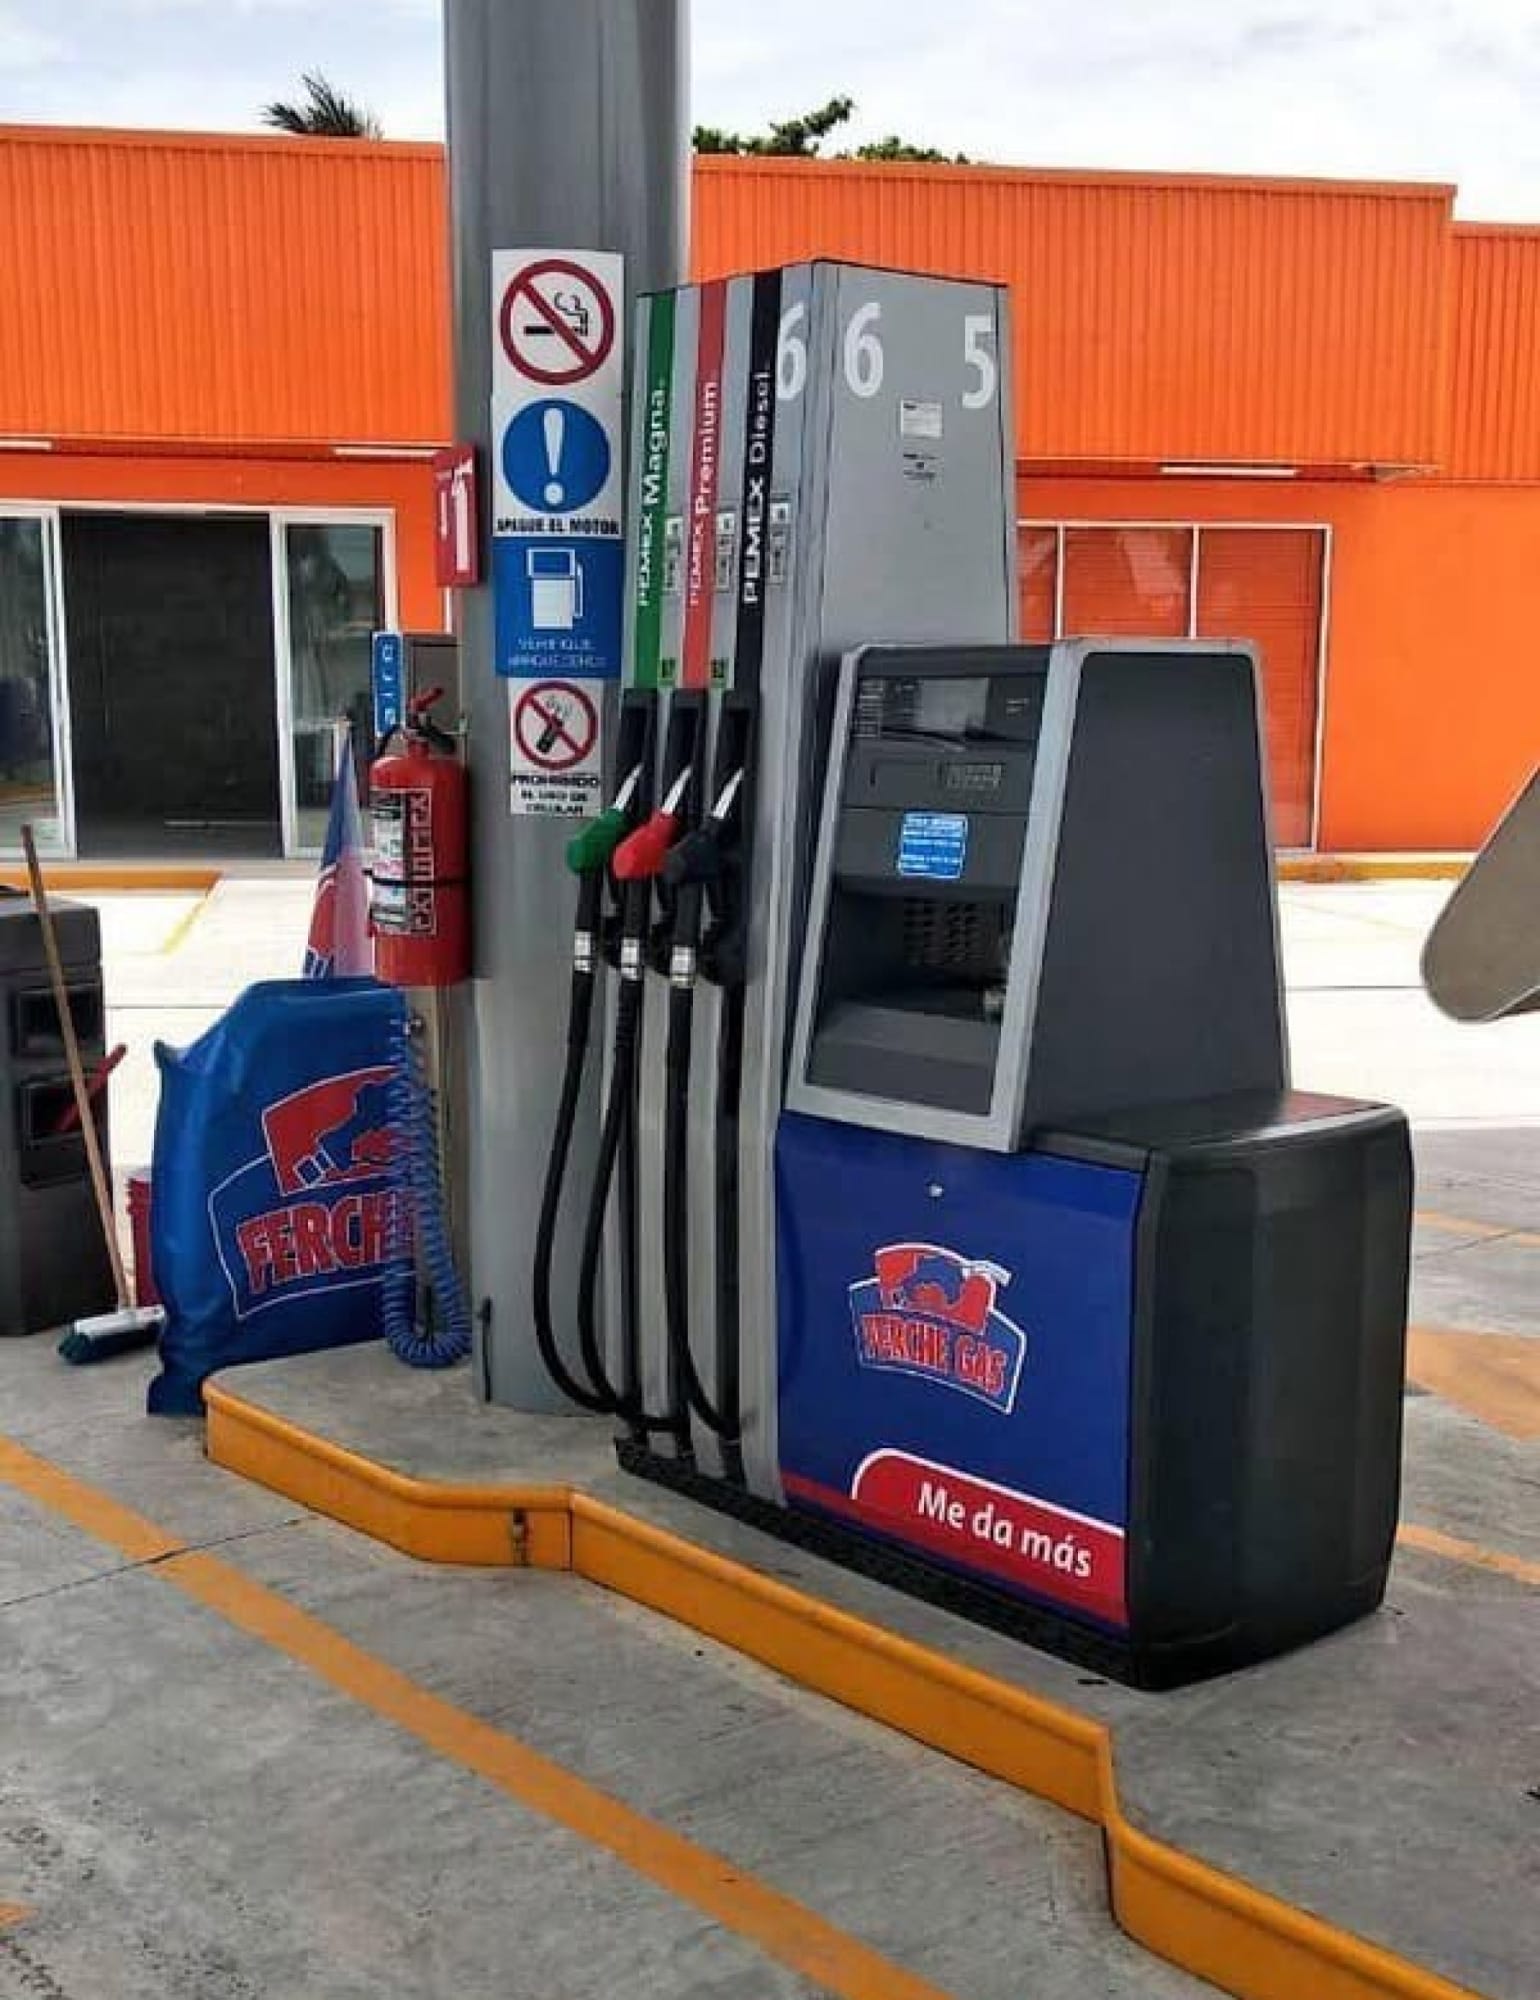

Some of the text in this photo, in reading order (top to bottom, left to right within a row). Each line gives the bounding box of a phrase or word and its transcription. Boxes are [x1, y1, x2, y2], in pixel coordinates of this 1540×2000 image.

[775, 301, 807, 400] 6
[844, 301, 996, 409] 6 5
[643, 388, 669, 505] Magna
[695, 382, 718, 515] Premium
[743, 371, 772, 604] PEMEX Diesel
[569, 518, 620, 535] MOTOR
[917, 1480, 1092, 1578] Me da más
